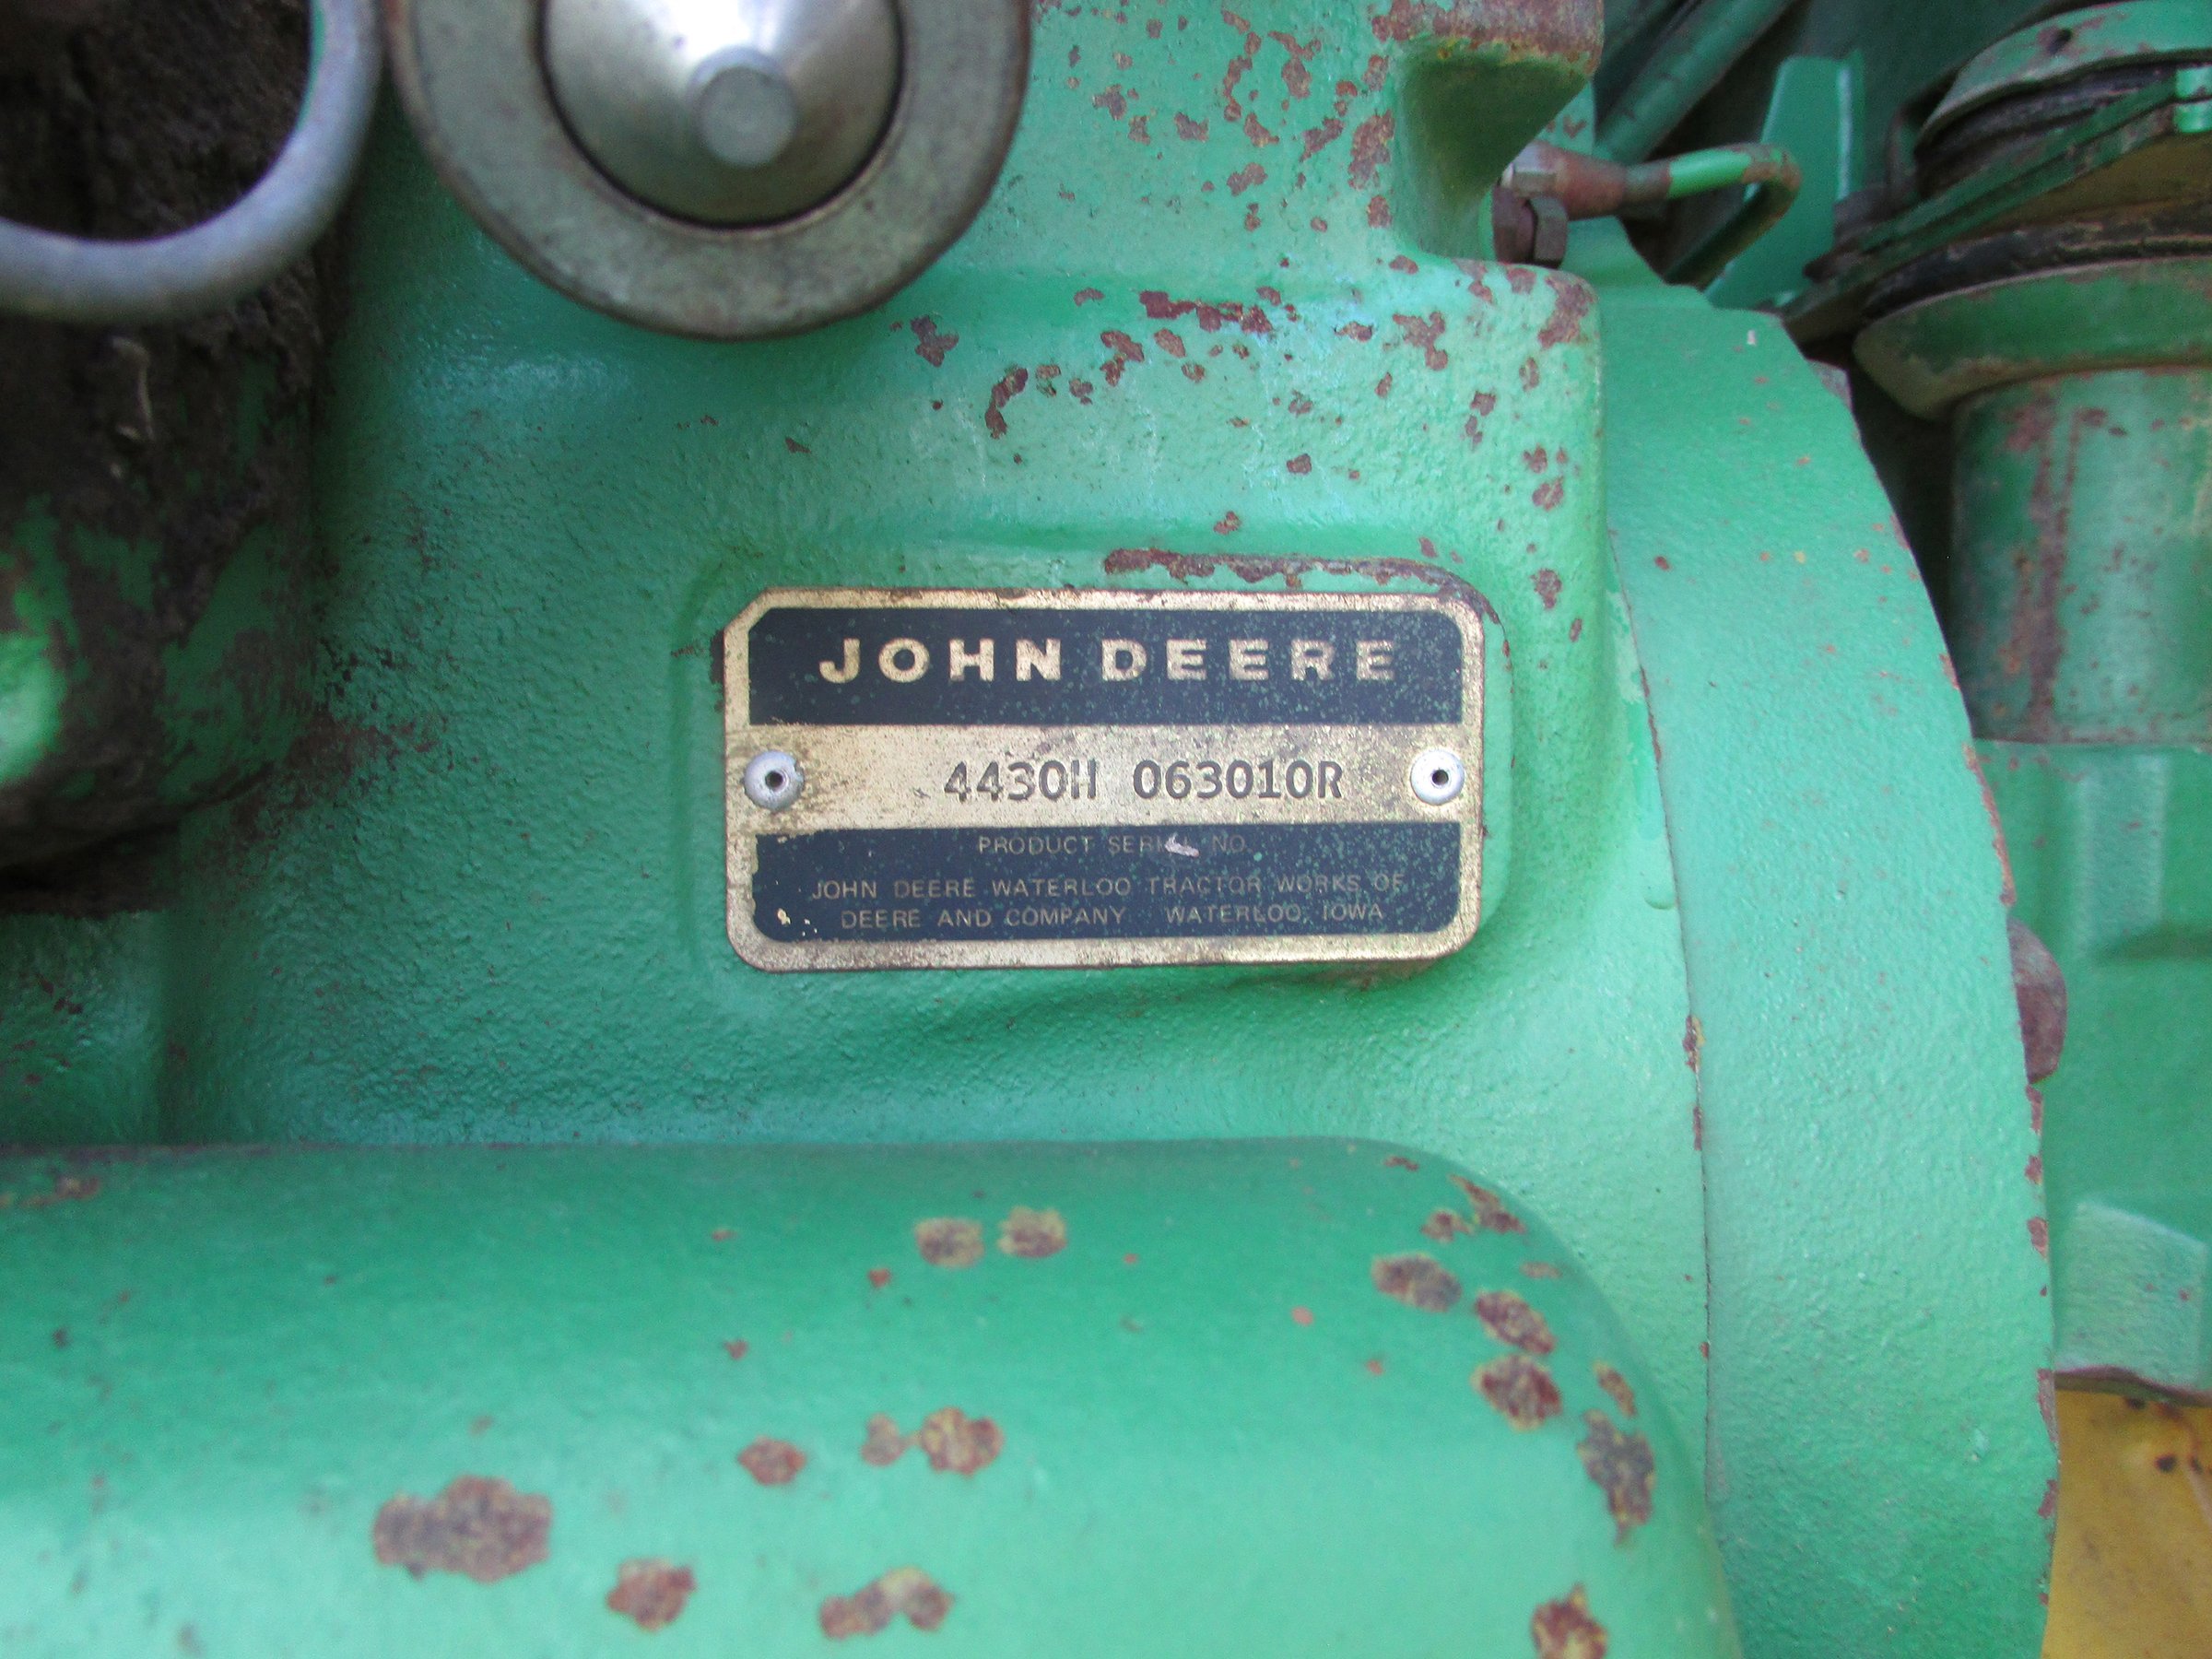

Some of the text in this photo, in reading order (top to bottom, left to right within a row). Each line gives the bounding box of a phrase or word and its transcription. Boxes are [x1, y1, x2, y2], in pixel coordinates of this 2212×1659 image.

[819, 637, 1395, 684] JOHN DEERE
[1133, 759, 1343, 800] 063010R
[978, 834, 1094, 855] PRODUCT
[811, 872, 1405, 900] JOHN DEERE WATERLOO TRACTOR WORKS OF
[840, 908, 923, 929] DEERE
[936, 907, 993, 928] AND
[1006, 906, 1127, 927] COMPANY
[1321, 902, 1384, 923] IOWA
